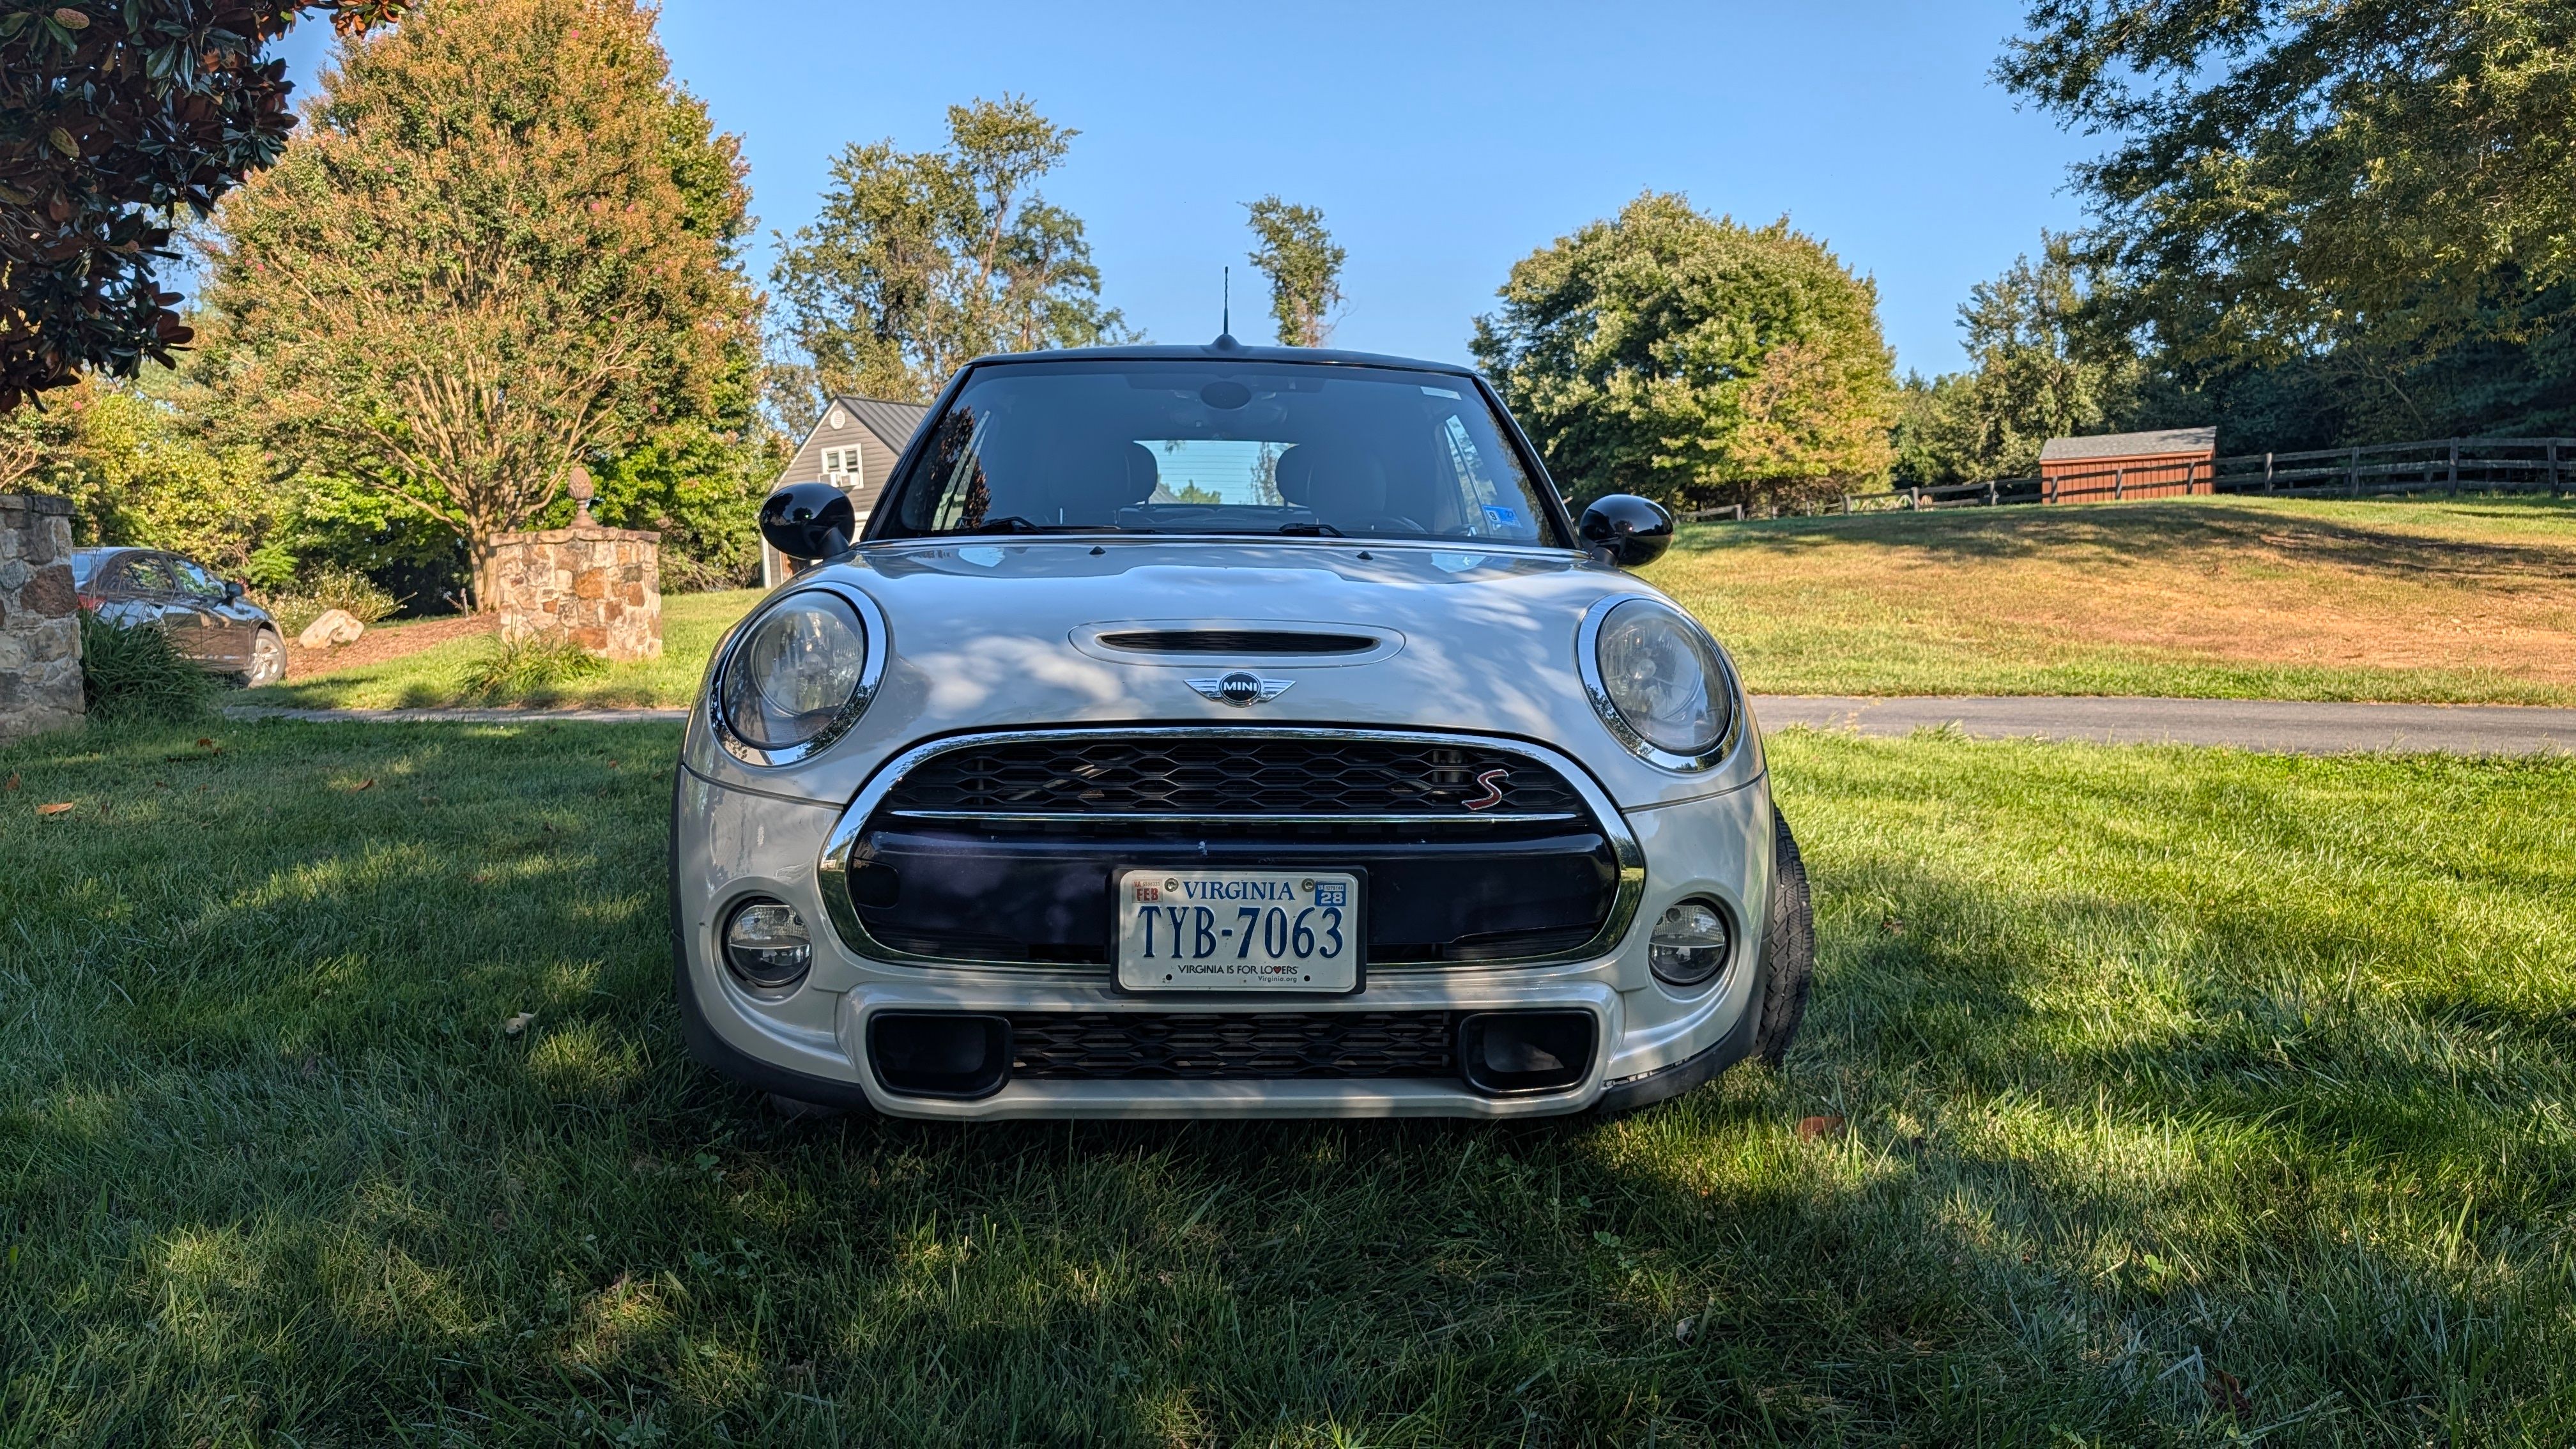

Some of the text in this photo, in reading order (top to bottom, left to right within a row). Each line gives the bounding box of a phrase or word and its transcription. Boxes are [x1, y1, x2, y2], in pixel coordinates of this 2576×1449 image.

[1223, 681, 1257, 691] MINI
[1461, 769, 1509, 811] S
[1137, 887, 1158, 901] FEB
[1182, 880, 1296, 901] VIRGINIA
[1321, 892, 1344, 904] 28
[1137, 905, 1344, 958] TYB-7063
[1177, 965, 1225, 974] VIRGINIA
[1226, 965, 1234, 974] IS
[1236, 965, 1259, 974] FOR
[1257, 975, 1298, 983] Virginia.org
